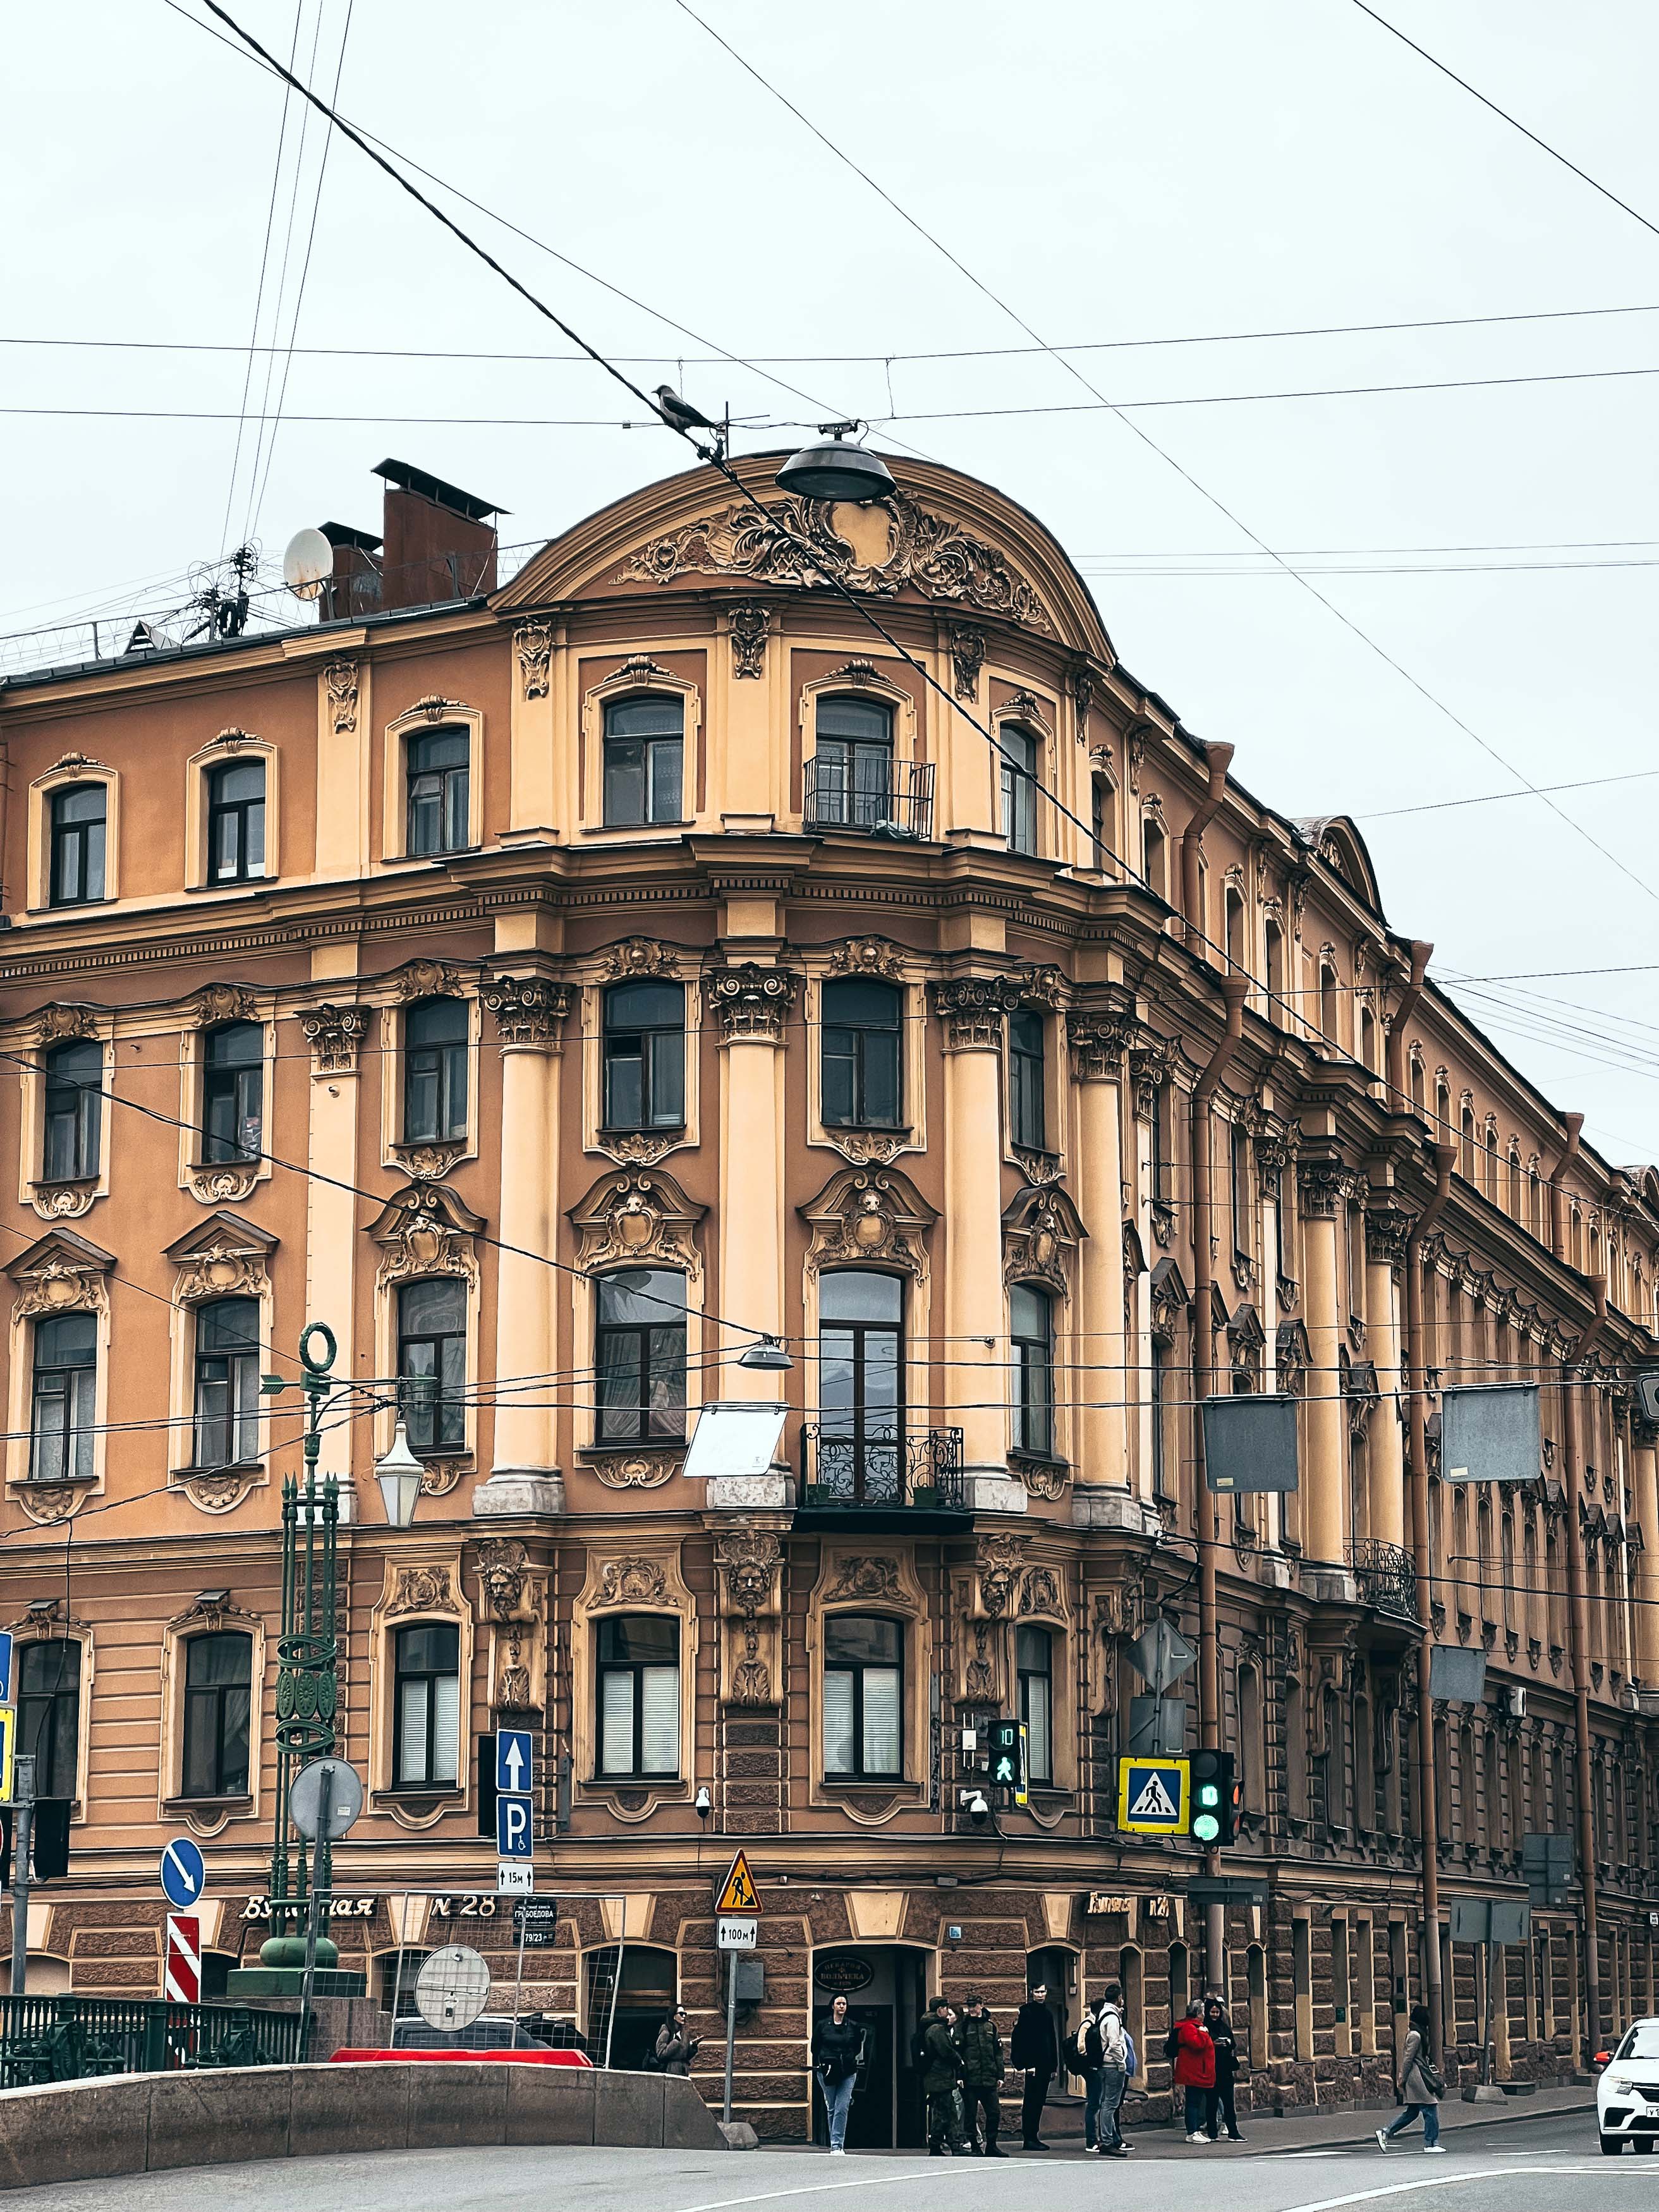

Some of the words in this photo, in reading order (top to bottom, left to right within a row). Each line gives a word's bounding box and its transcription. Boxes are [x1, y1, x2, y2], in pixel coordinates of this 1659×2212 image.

[1001, 1729, 1013, 1745] 10
[507, 1803, 526, 1850] P
[459, 1895, 495, 1917] 28
